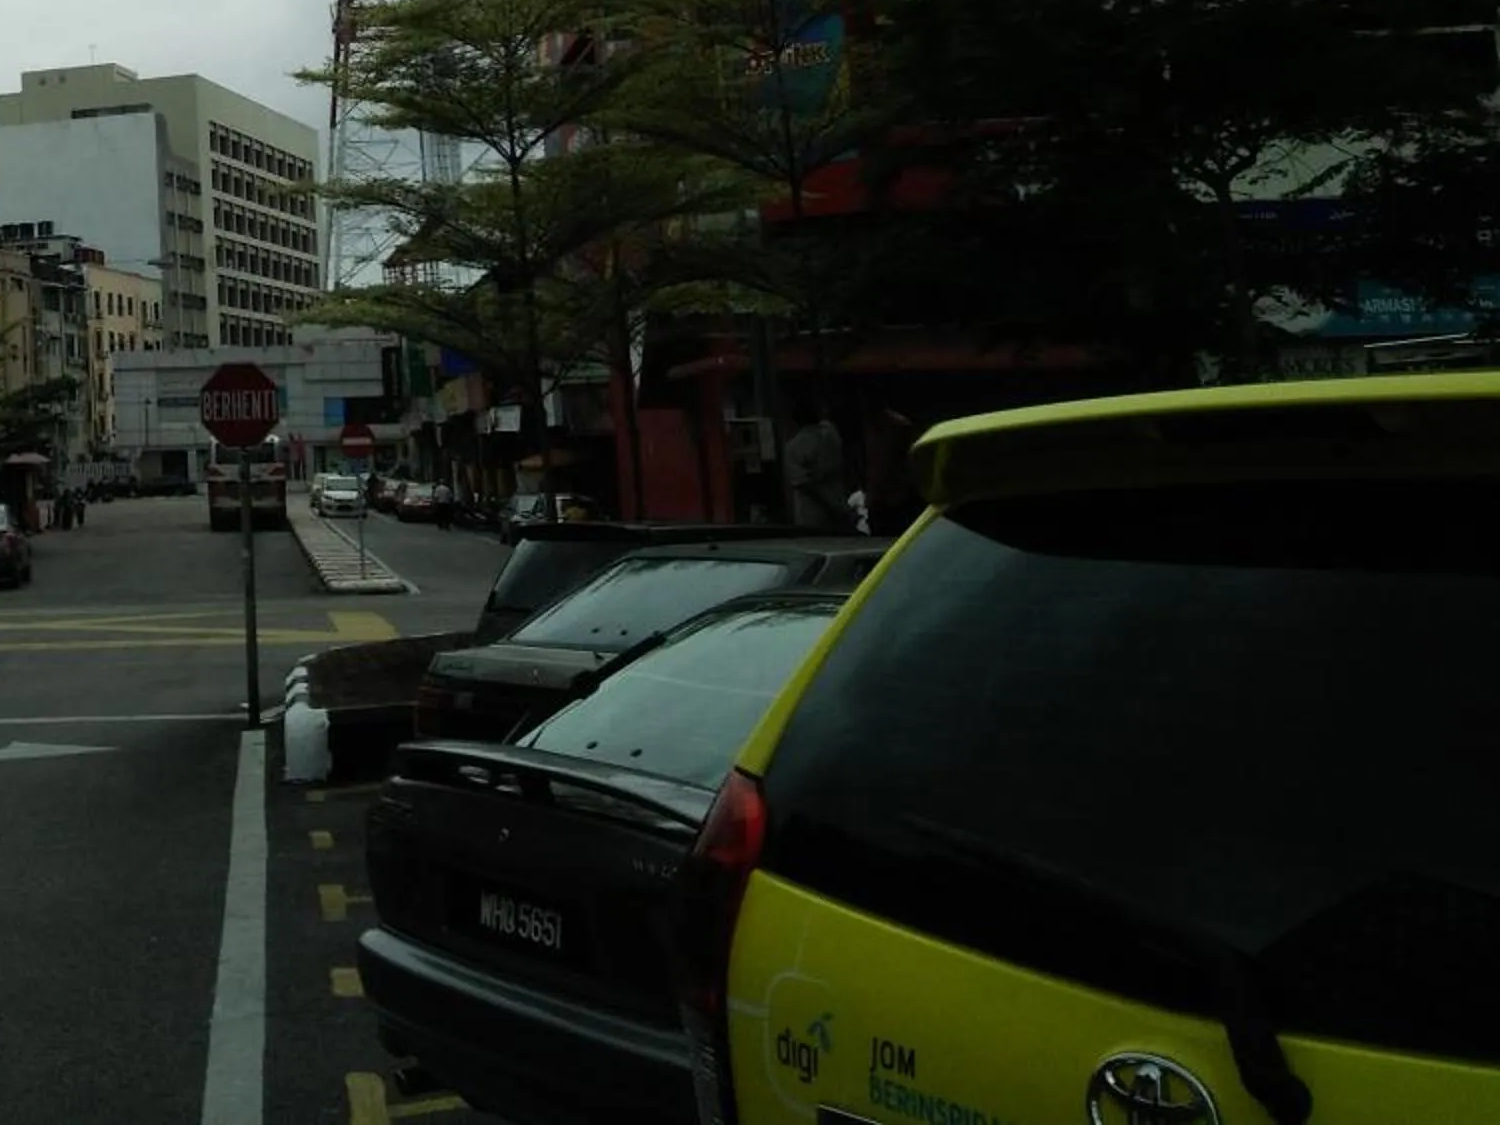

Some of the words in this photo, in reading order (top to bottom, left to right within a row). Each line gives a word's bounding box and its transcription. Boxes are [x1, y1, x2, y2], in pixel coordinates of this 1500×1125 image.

[1358, 297, 1415, 313] ARMASI
[202, 388, 277, 422] BERHENTI
[517, 902, 562, 950] 5651
[776, 1026, 820, 1083] digi
[869, 1036, 917, 1080] JOM
[868, 1073, 1003, 1125] BERINSPIR
